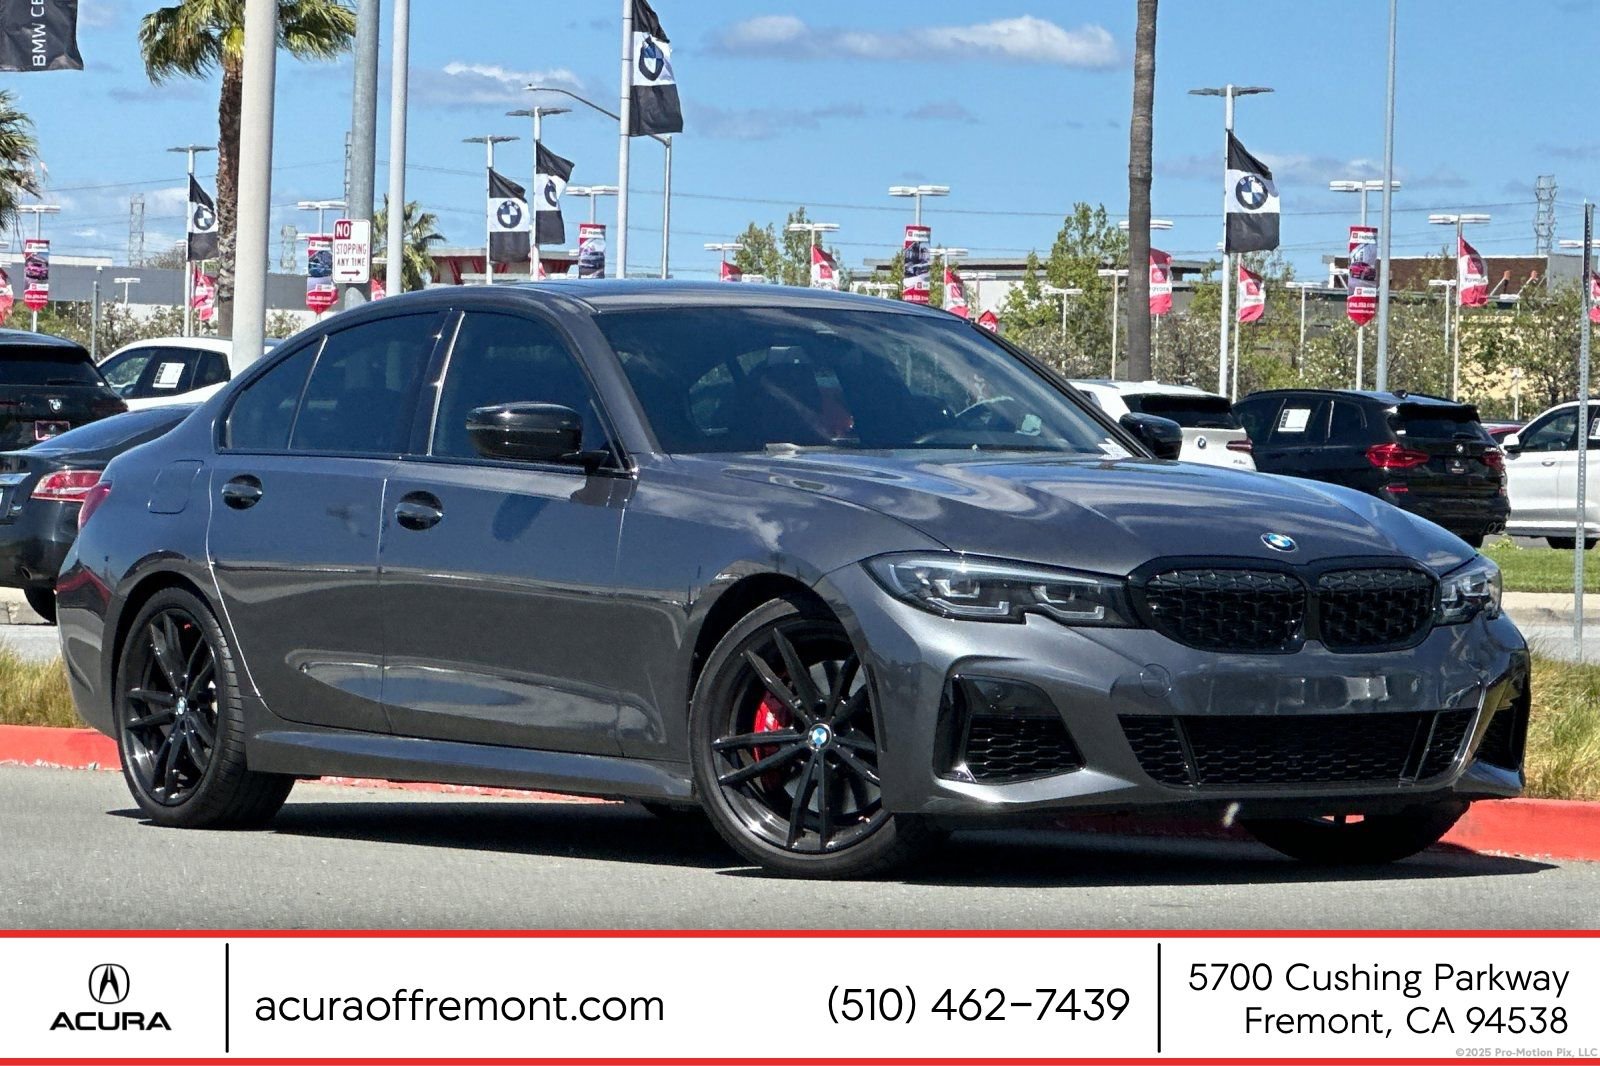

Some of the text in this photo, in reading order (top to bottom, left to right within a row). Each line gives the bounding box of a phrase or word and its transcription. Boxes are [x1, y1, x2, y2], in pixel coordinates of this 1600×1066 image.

[32, 23, 46, 66] BMW
[336, 223, 350, 237] NO
[336, 243, 367, 255] STOPPING
[337, 257, 366, 267] ANY TIME
